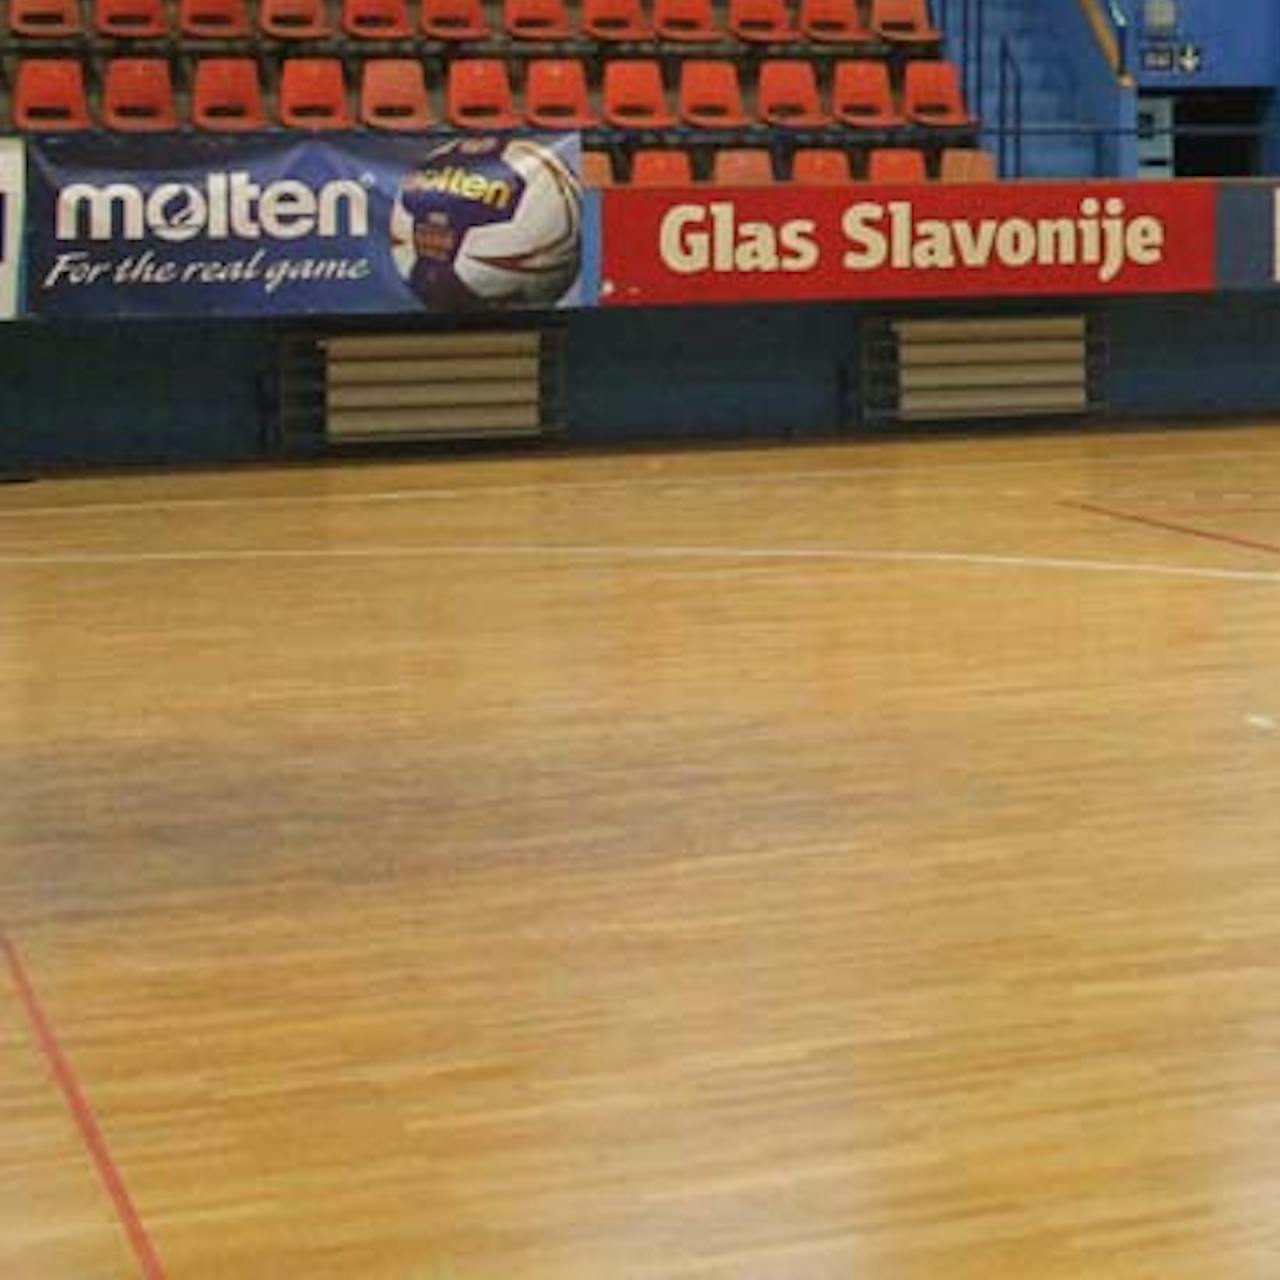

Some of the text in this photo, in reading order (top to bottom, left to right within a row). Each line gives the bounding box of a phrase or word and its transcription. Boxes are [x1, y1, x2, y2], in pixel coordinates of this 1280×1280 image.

[56, 172, 369, 240] molten
[659, 197, 1165, 283] Glas Slavonije
[44, 248, 372, 294] For the real game
